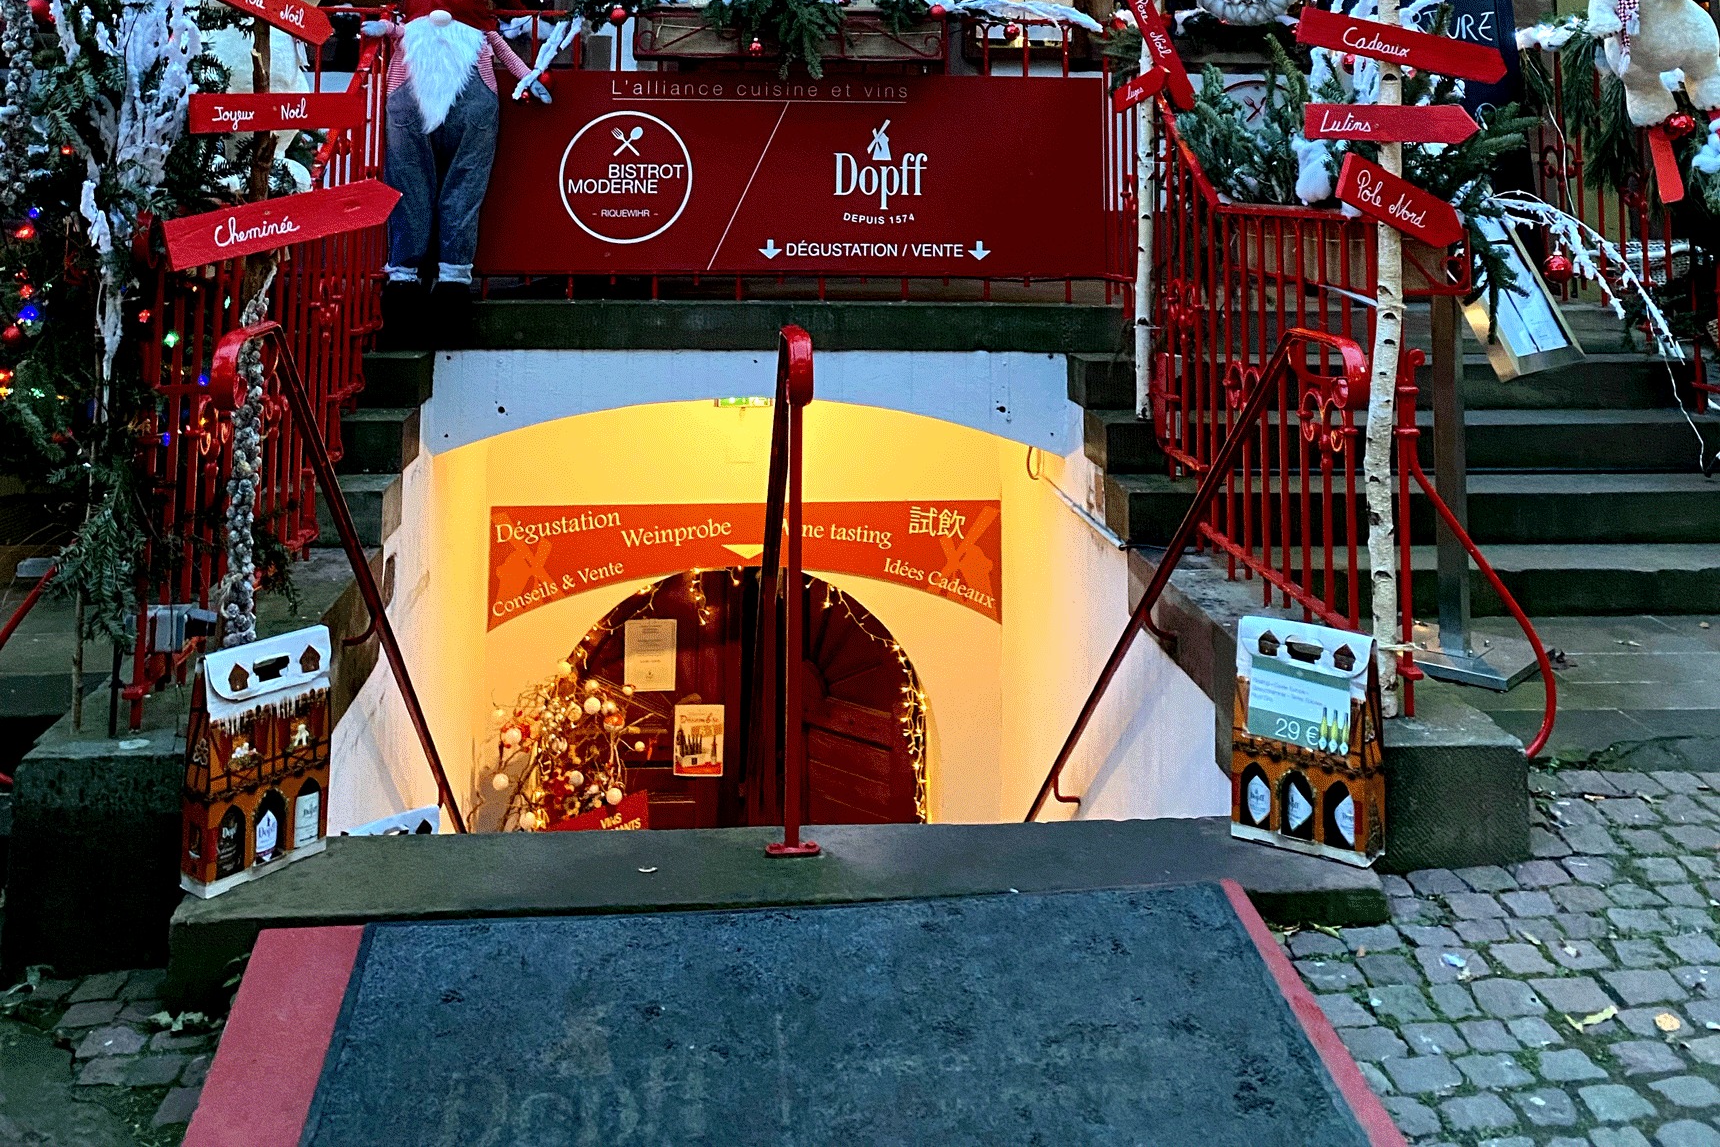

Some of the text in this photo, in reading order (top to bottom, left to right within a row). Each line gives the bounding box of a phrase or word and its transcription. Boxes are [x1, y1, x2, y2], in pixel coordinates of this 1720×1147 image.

[279, 4, 305, 29] Noël
[1149, 31, 1172, 59] Noël
[1342, 26, 1411, 58] Cadeaux
[611, 80, 908, 99] L'alliance cuisine et vins
[211, 97, 308, 131] Joyeux Noël
[1319, 109, 1372, 133] Lutins
[608, 164, 685, 179] BISTROT
[833, 152, 928, 210] Dopff
[568, 179, 659, 194] MODERNE
[1356, 169, 1427, 228] Pôle Nord
[601, 209, 650, 218] RIQUEWIHR
[843, 212, 915, 225] DEPUIS 1574
[214, 215, 301, 247] Cheminée
[786, 240, 898, 257] DÉGUSTATION
[911, 243, 964, 257] VENTE
[495, 510, 622, 545] Dégustation
[620, 518, 732, 548] Weinprobe
[830, 523, 893, 550] tasting
[908, 505, 966, 539] 試飲
[492, 561, 625, 618] Conseils & Vente
[884, 557, 997, 609] Idées Cadeaux
[1274, 717, 1320, 746] 29 €
